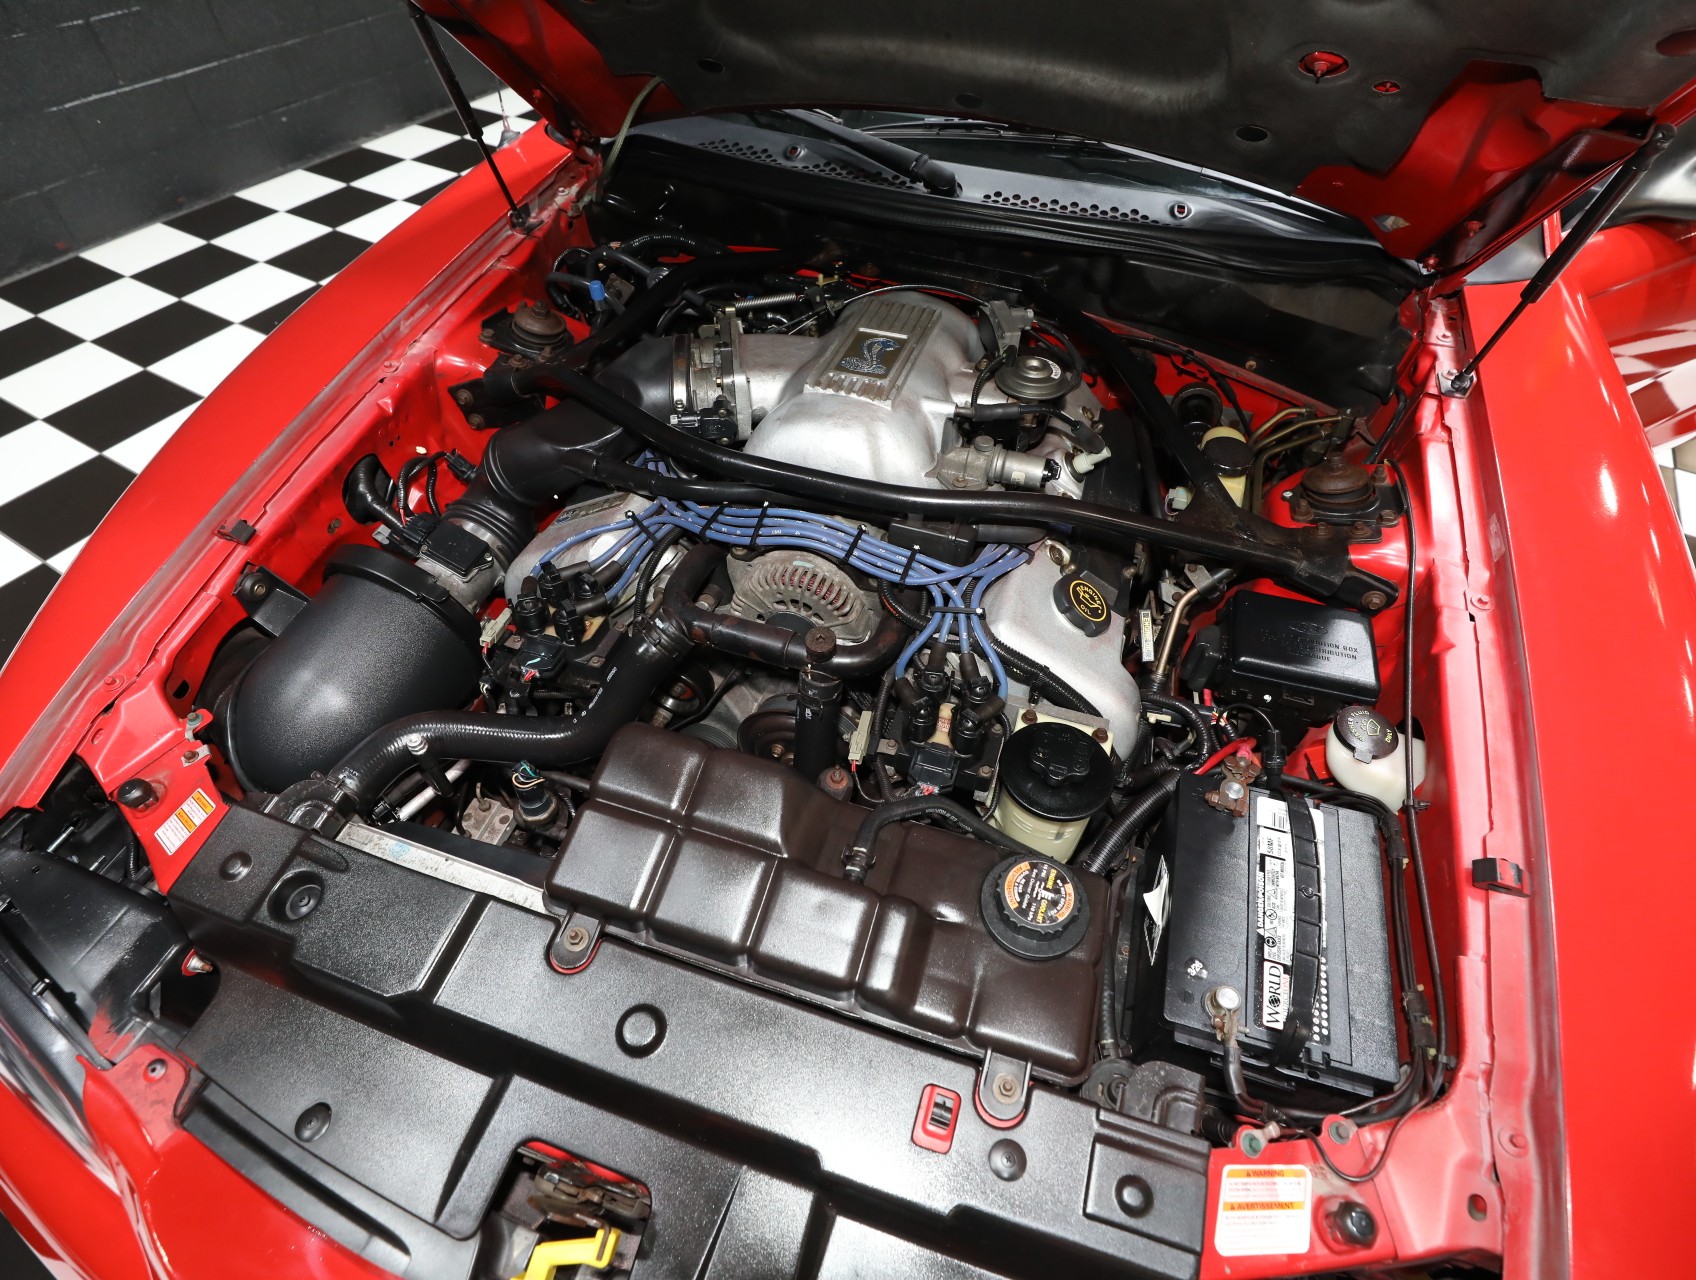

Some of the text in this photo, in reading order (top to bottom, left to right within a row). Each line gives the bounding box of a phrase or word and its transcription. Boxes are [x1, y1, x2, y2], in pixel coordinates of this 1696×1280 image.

[1080, 585, 1102, 605] ENGINE
[1080, 604, 1092, 615] OIL
[1342, 645, 1359, 654] BOX
[1347, 717, 1365, 742] WASHER
[1385, 728, 1393, 743] ONLY
[1046, 869, 1057, 889] ENGINE
[1036, 899, 1048, 924] COOLANT
[1266, 965, 1282, 1024] WORLD
[1252, 1169, 1285, 1178] WARNING
[1237, 1202, 1294, 1211] AVERTISSEMENT
